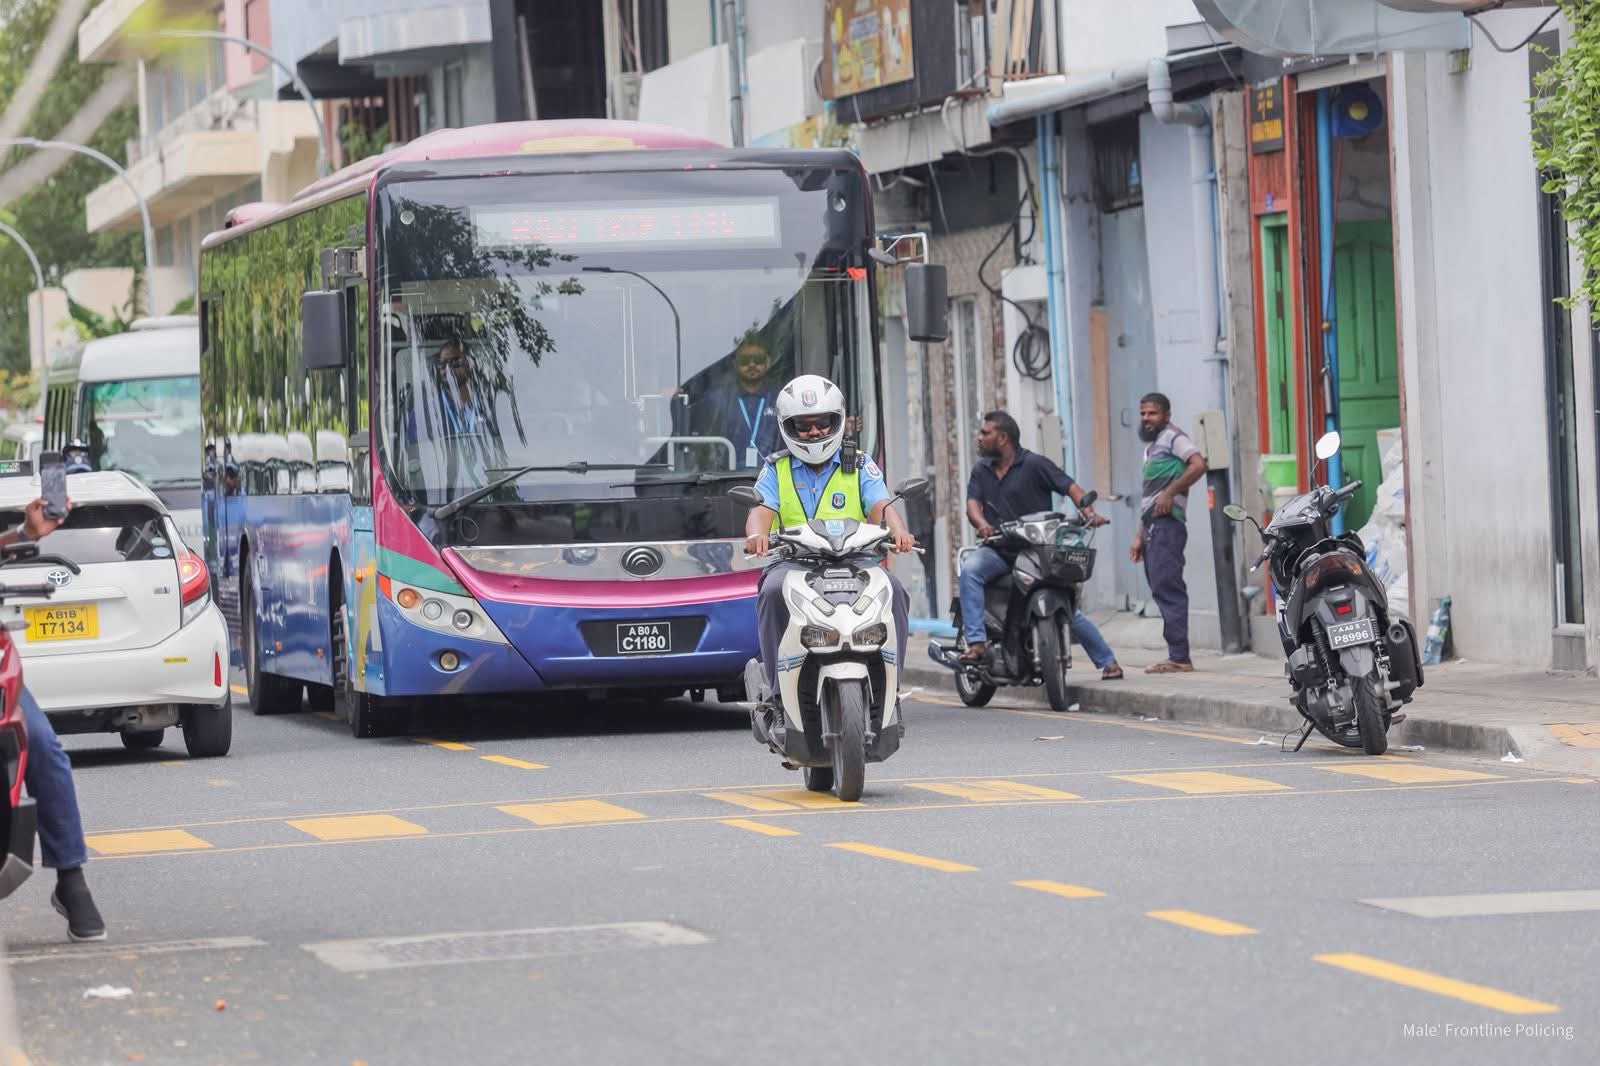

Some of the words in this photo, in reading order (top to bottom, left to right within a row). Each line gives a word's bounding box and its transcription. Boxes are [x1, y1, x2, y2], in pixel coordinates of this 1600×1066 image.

[46, 611, 54, 619] A
[40, 620, 85, 635] T7134
[629, 626, 636, 635] A
[651, 625, 659, 635] A
[622, 635, 666, 650] C1180
[1334, 630, 1369, 645] P8996
